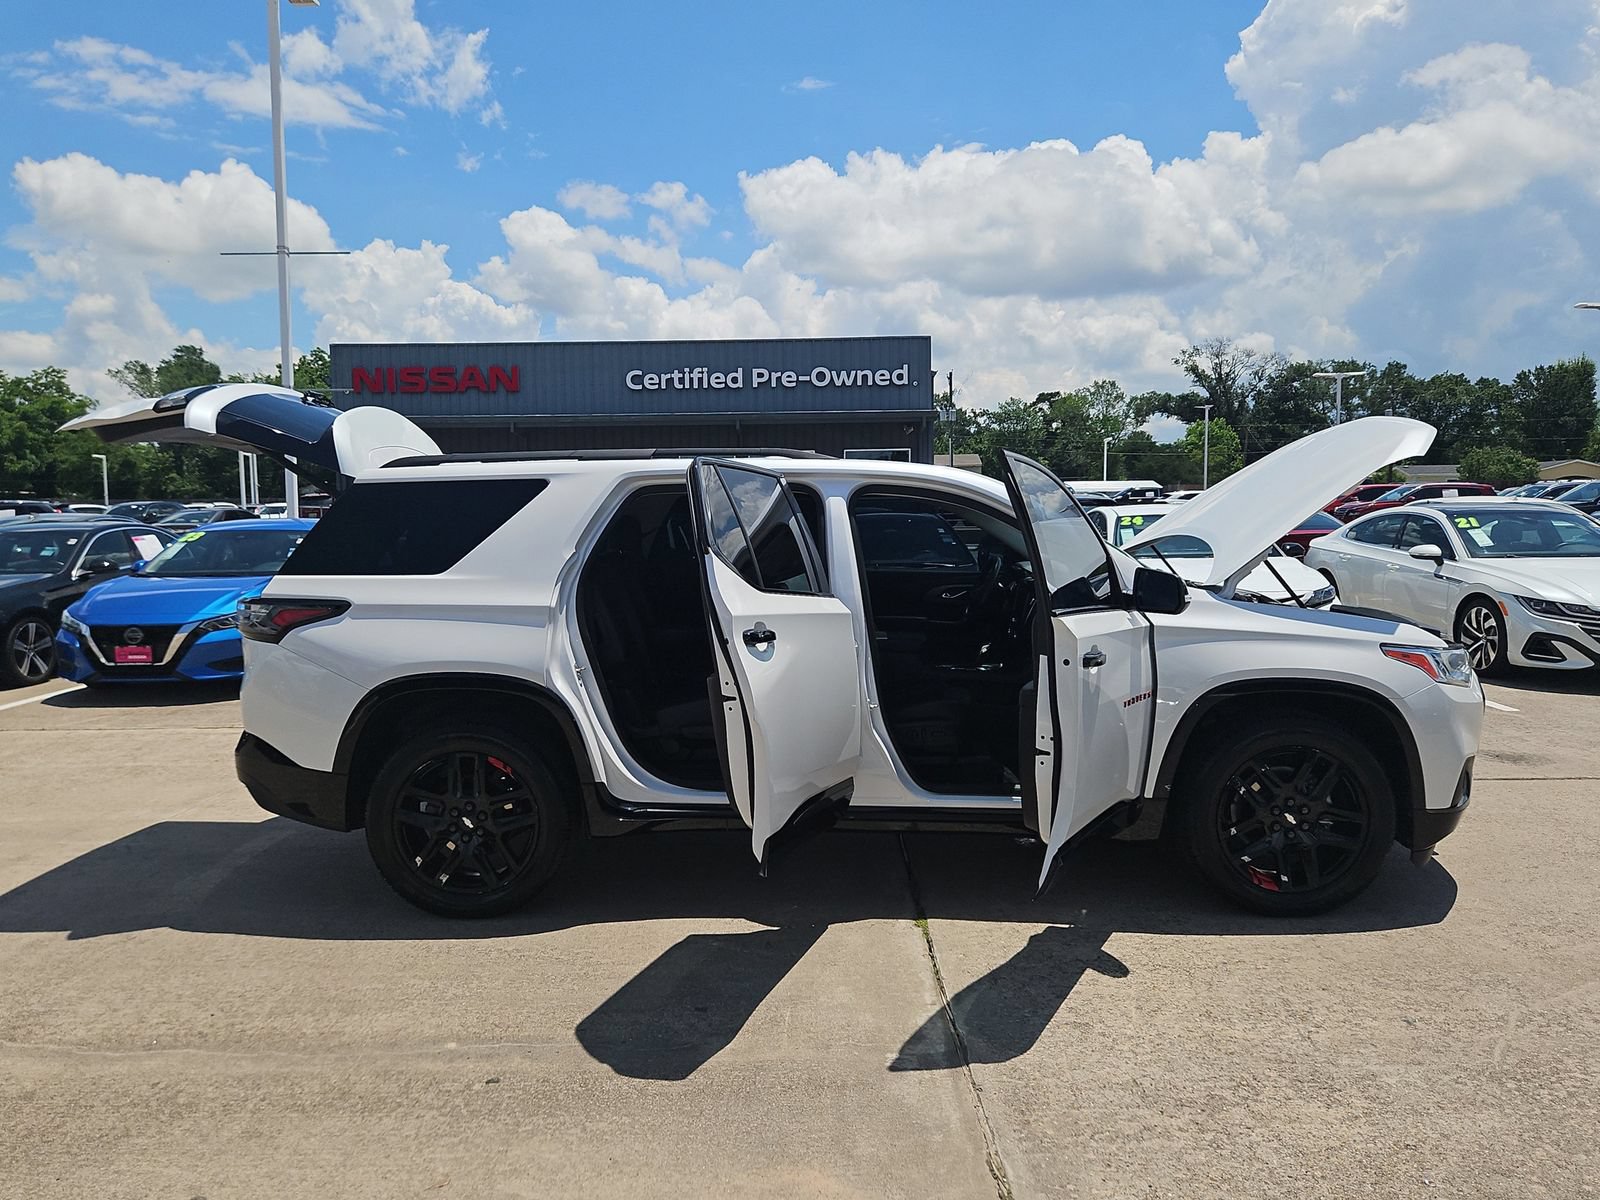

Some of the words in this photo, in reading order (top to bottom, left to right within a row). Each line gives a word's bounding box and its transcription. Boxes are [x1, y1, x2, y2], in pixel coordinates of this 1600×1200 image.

[352, 366, 520, 393] NISSAN
[625, 367, 744, 390] Certified
[1120, 516, 1144, 526] 24
[1454, 517, 1480, 528] 21
